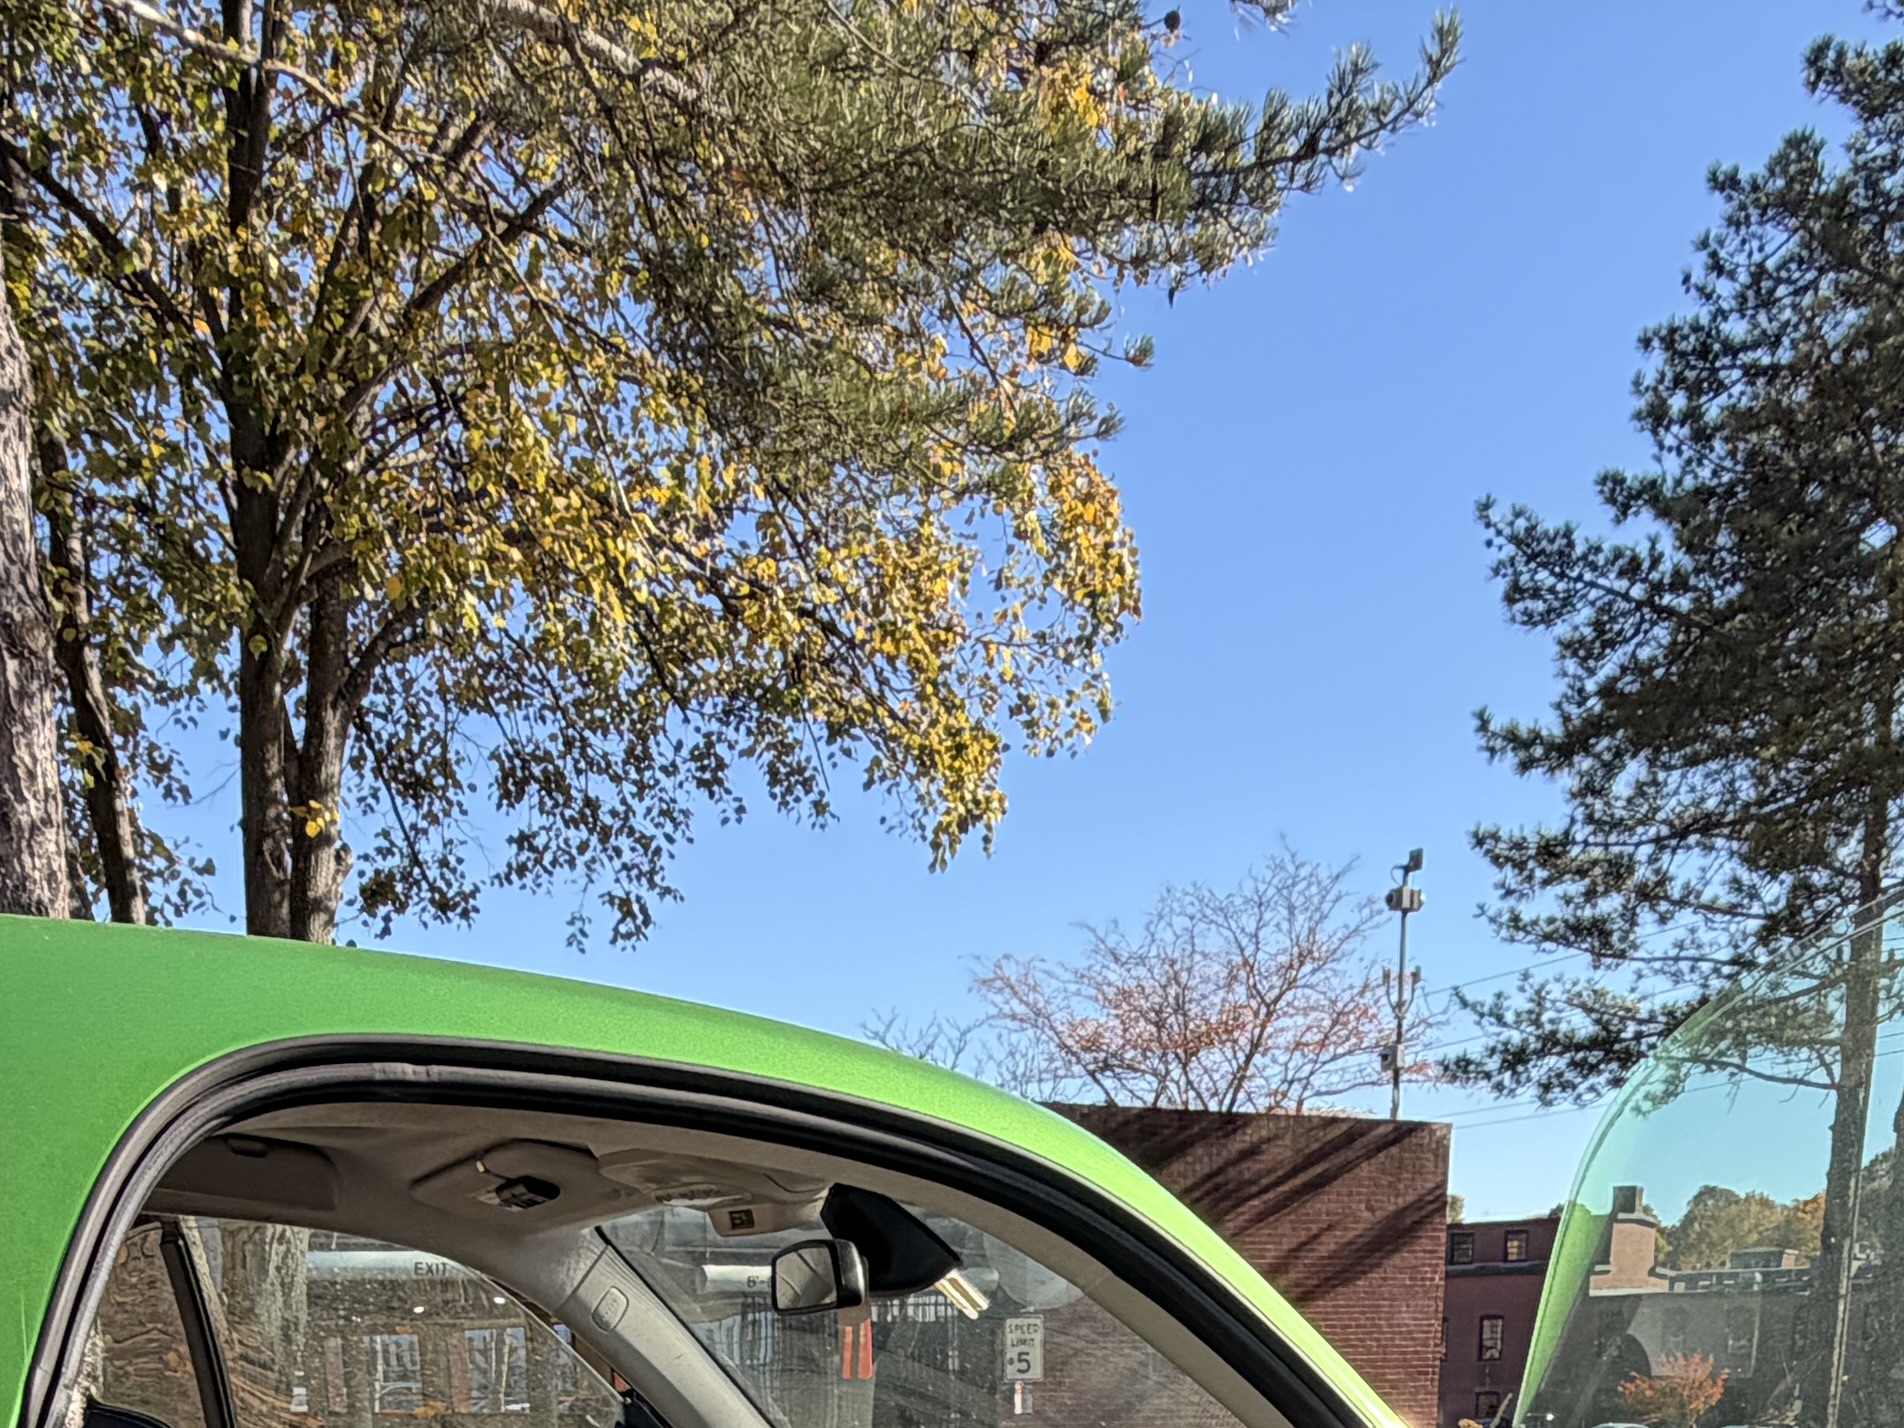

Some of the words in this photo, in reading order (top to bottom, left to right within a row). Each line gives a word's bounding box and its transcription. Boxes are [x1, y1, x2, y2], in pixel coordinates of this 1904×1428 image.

[414, 1261, 448, 1276] EXIT
[1008, 1323, 1040, 1335] SPEED
[1011, 1338, 1035, 1348] LIMIT
